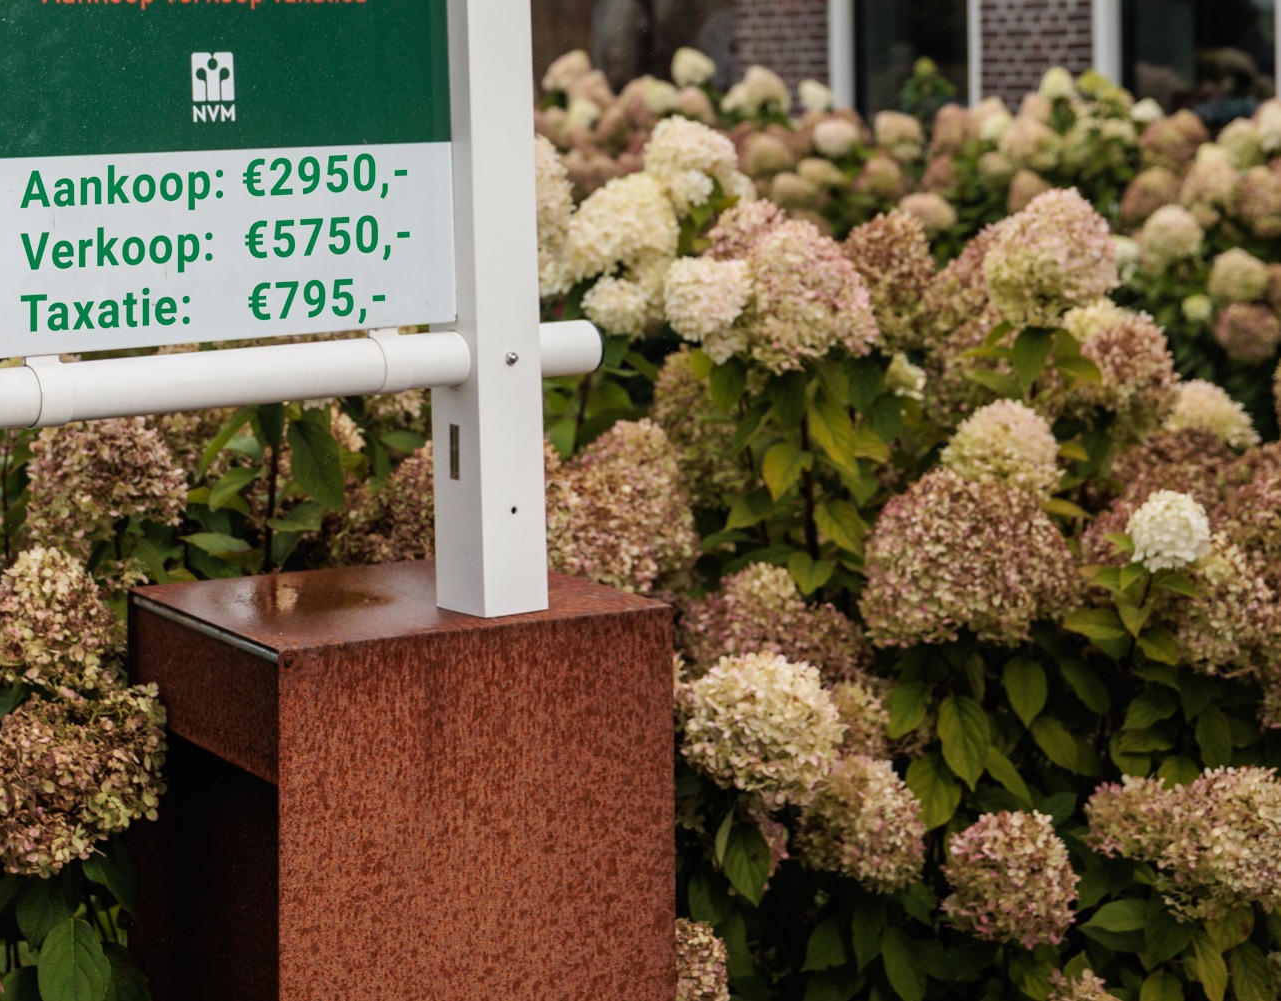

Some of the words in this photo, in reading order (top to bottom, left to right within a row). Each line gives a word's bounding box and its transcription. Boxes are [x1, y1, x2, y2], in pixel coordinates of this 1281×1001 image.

[192, 105, 236, 123] NVM
[20, 165, 224, 210] Aankoop:
[242, 153, 409, 198] €2950,-
[20, 227, 214, 272] Verkoop:
[244, 215, 411, 260] €5750,-
[20, 288, 191, 333] Taxatie:
[248, 278, 387, 324] €795,-
